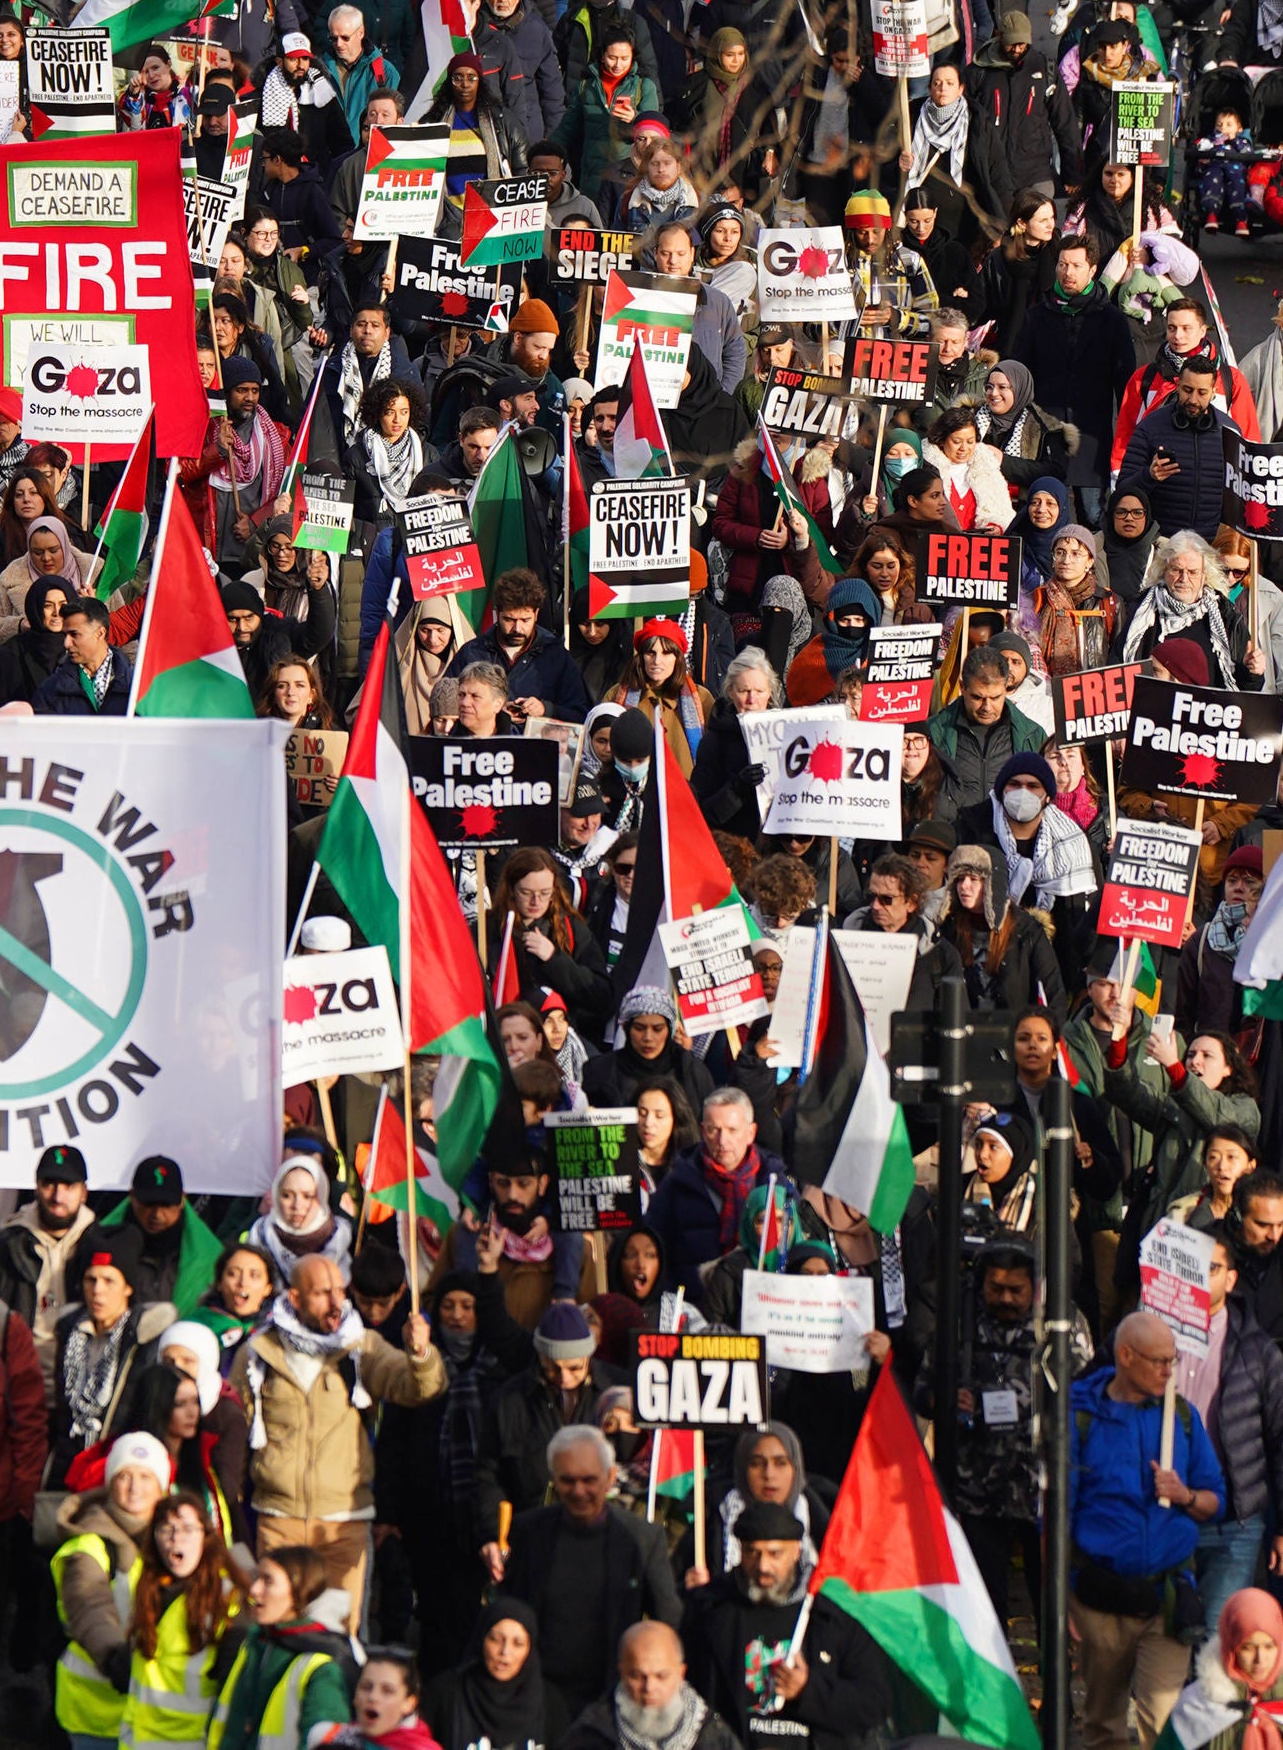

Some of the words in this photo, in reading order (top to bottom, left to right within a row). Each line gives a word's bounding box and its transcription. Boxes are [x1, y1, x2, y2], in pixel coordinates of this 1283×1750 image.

[31, 40, 108, 62] CEASEFIRE
[1118, 92, 1145, 106] FROM
[1146, 92, 1164, 106] THE
[1117, 116, 1136, 129] THE
[1137, 116, 1155, 129] SEA
[1117, 128, 1165, 142] PALESTINE
[1116, 151, 1139, 164] FREE
[31, 172, 104, 193] DEMAND
[107, 172, 123, 193] A
[376, 167, 436, 189] FREE
[364, 189, 438, 202] PALESTINE
[494, 178, 547, 203] CEASE
[20, 196, 126, 217] CEASEFIRE
[500, 206, 543, 231] FIRE
[503, 236, 537, 258] NOW
[559, 229, 595, 251] END
[601, 231, 634, 252] THE
[400, 261, 515, 304] Palestine
[851, 339, 930, 383] FREE
[774, 369, 802, 388] STOP
[849, 378, 926, 401] PALESTINE
[29, 403, 55, 419] Stop
[58, 404, 81, 418] the
[83, 406, 143, 418] massacre
[763, 387, 843, 436] GAZA
[1238, 444, 1283, 478] Free
[403, 503, 464, 531] FREEDOM
[595, 492, 686, 524] CEASEFIRE
[406, 525, 472, 555] PALESTINE
[927, 533, 1009, 582] FREE
[420, 564, 475, 592] لفلسطين
[926, 575, 1009, 602] PALESTINE
[874, 638, 934, 659] FREEDOM
[867, 661, 934, 683] PALESTINE
[1171, 690, 1243, 731] Free
[303, 734, 325, 756] NO
[1132, 715, 1275, 764] Palestine
[302, 756, 324, 774] TO
[443, 745, 515, 776] Free
[785, 735, 891, 782] Gza
[412, 775, 552, 808] Palestine
[777, 790, 798, 807] Stop
[801, 791, 824, 806] the
[828, 793, 891, 810] massacre
[1119, 835, 1191, 866] FREEDOM
[96, 791, 196, 939] WAR
[1109, 864, 1190, 895] PALESTINE
[314, 976, 381, 1017] za
[308, 1026, 386, 1046] massacre
[554, 1127, 596, 1144] FROM
[598, 1124, 628, 1142] THE
[556, 1143, 597, 1161] RIVER
[599, 1141, 621, 1160] TO
[558, 1175, 634, 1195] PALESTINE
[560, 1211, 597, 1231] FREE
[1151, 1238, 1169, 1255] END
[637, 1334, 679, 1359] STOP
[681, 1336, 761, 1361] BOMBING
[635, 1358, 764, 1426] GAZA
